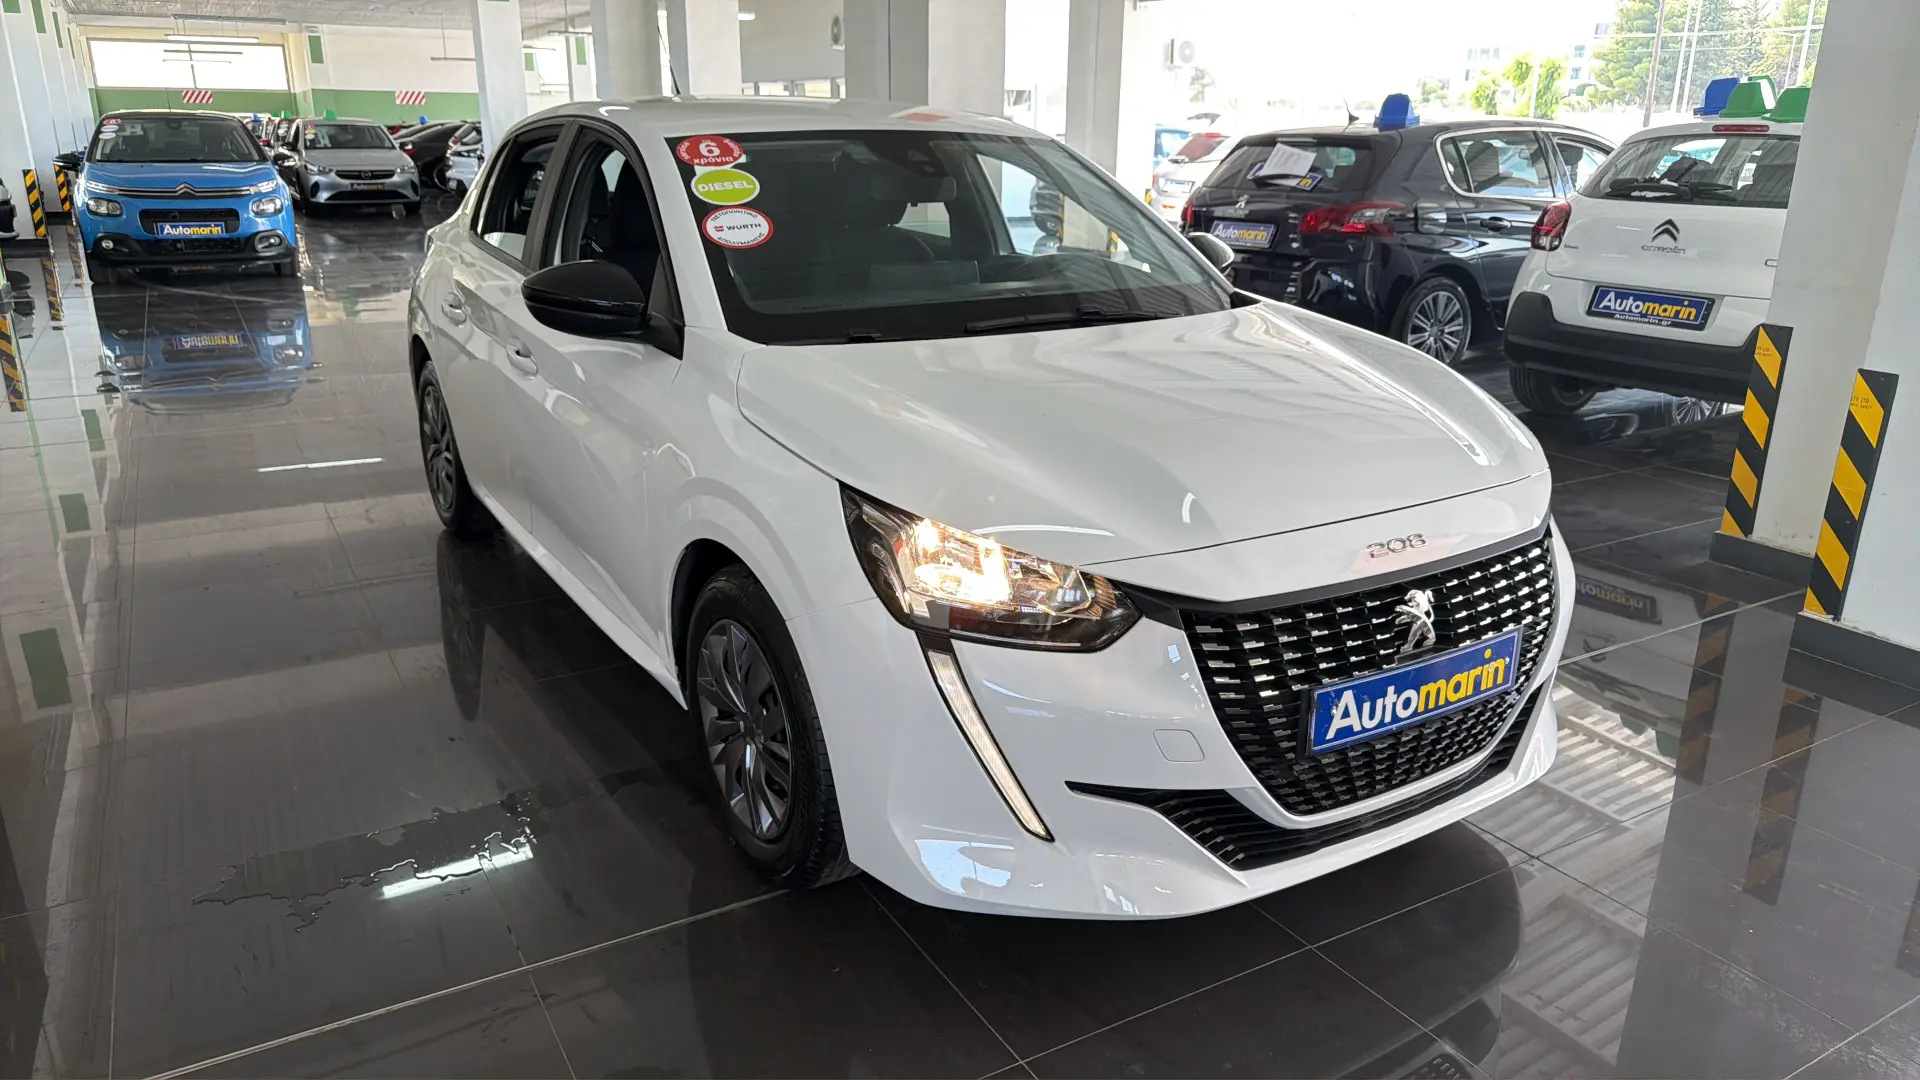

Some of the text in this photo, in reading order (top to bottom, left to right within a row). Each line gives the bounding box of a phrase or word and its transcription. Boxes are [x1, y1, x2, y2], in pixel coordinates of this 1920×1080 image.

[699, 142, 721, 157] 6
[693, 156, 734, 165] χρόνια
[697, 180, 754, 193] DIESEL
[163, 224, 222, 235] Automarin
[1214, 223, 1268, 241] Automarin
[1598, 291, 1697, 321] Automarin
[1613, 313, 1673, 326] Automarin.gr
[1366, 533, 1428, 559] 208
[1325, 648, 1508, 741] Automarin
